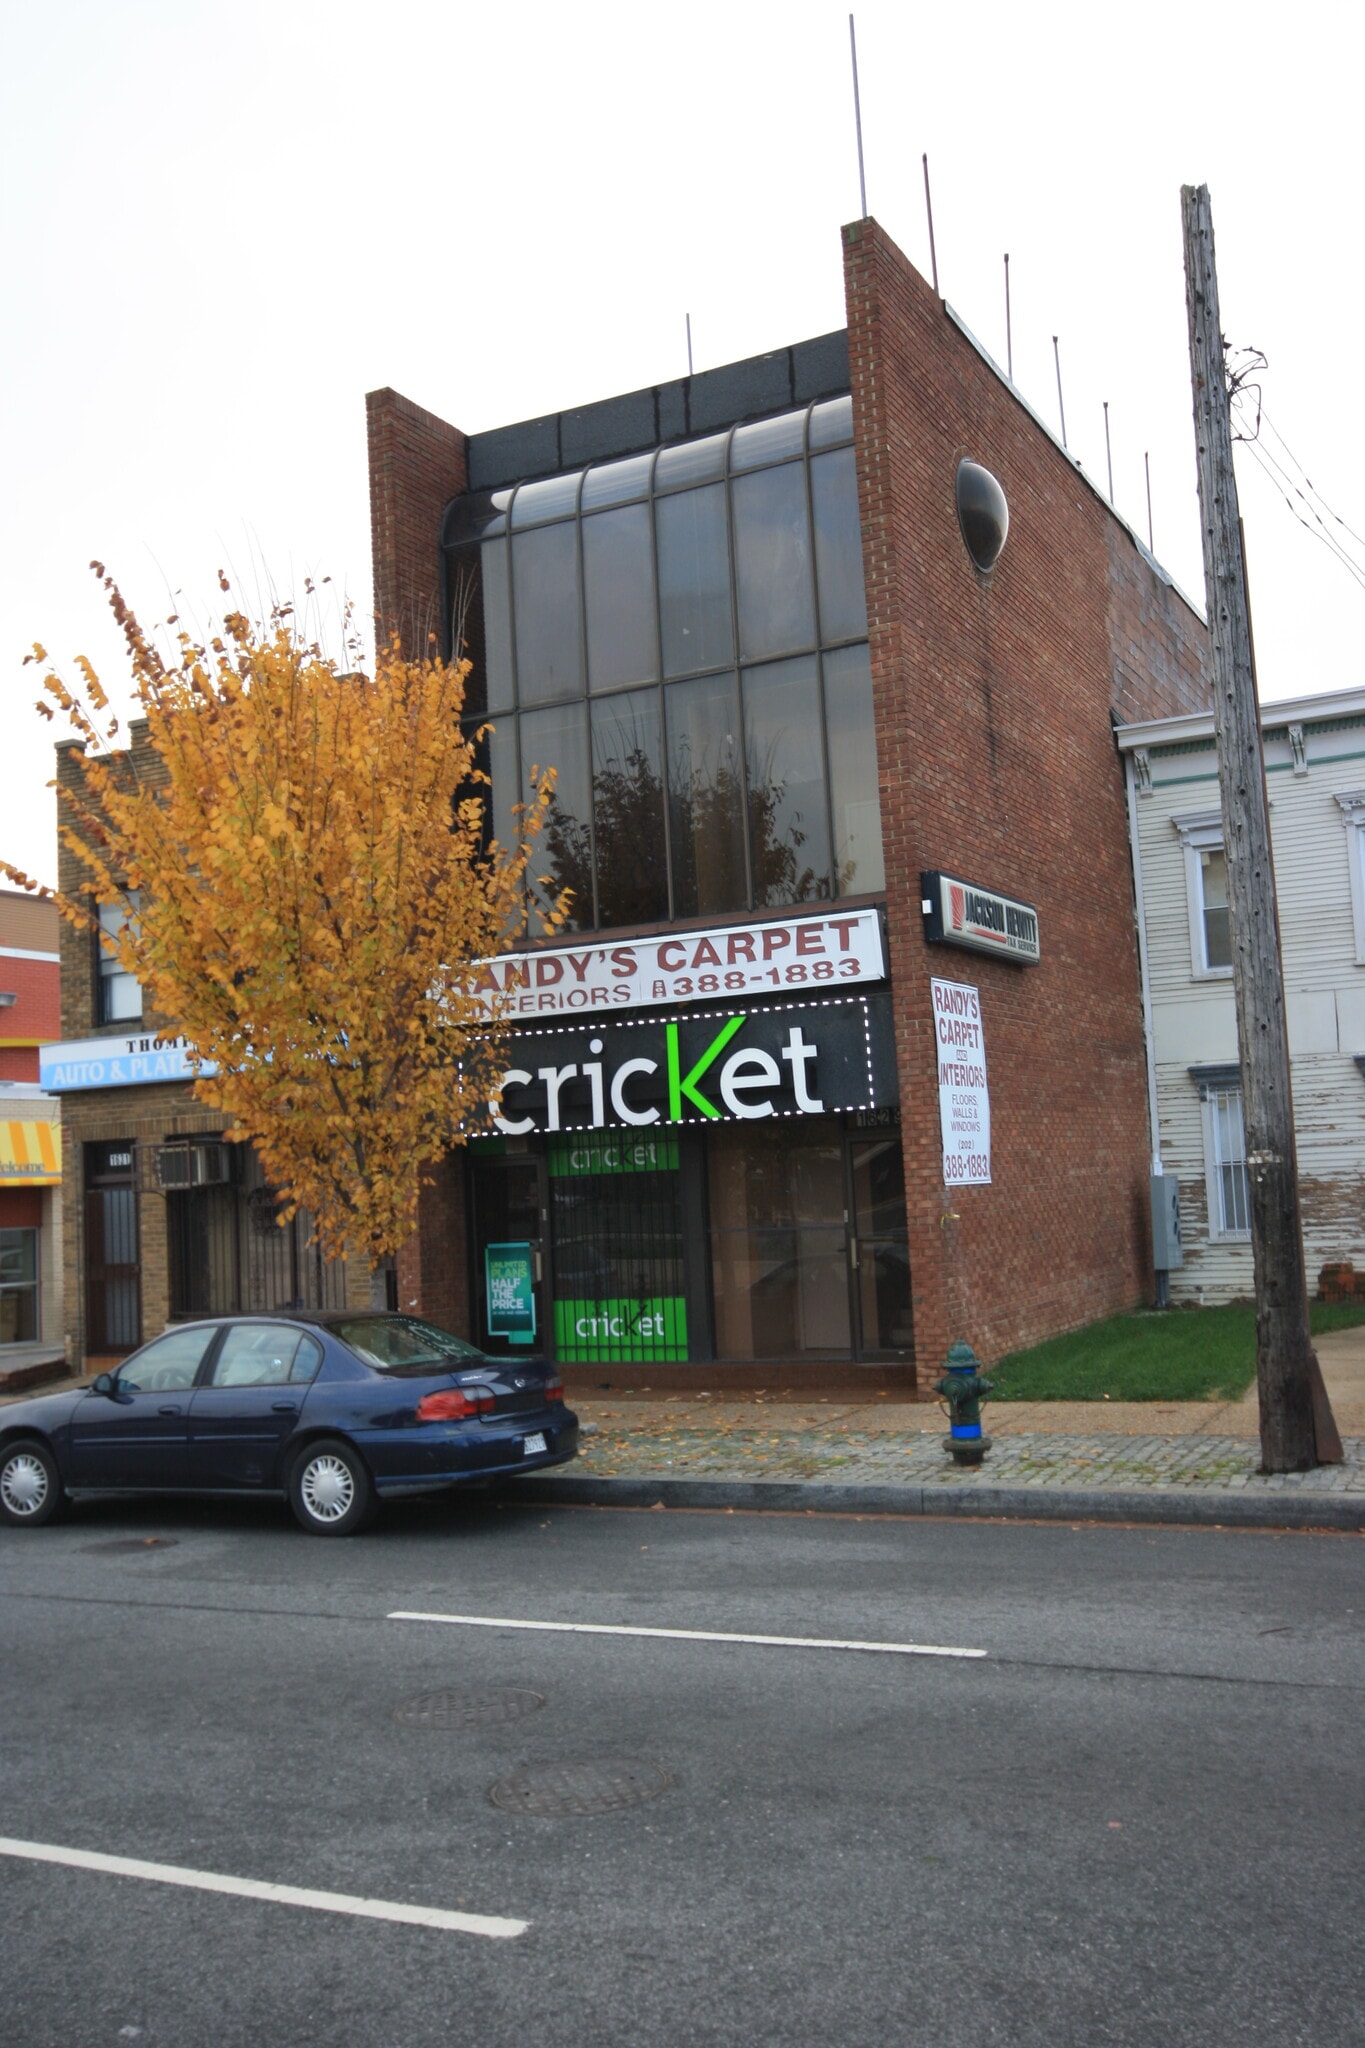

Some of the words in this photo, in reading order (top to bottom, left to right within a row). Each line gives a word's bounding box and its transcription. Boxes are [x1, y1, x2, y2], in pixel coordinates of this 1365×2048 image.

[964, 890, 1005, 933] JACKSON
[1005, 904, 1037, 943] HEWITT
[656, 917, 860, 972] CARPET
[1017, 938, 1037, 954] SERVICE
[673, 958, 861, 996] 388-1883
[934, 985, 978, 1019] RANDY'S
[938, 1017, 979, 1049] CARPET
[53, 1062, 104, 1086] AUTO
[110, 1060, 126, 1080] &
[939, 1062, 984, 1088] INTERIORS
[951, 1108, 973, 1119] WALLS
[951, 1121, 980, 1132] WINDOWS
[958, 1139, 975, 1150] (202)
[945, 1154, 988, 1178] 388-1883
[490, 1268, 528, 1279] PLANS
[491, 1278, 521, 1289] HALF
[492, 1288, 514, 1299] THE
[492, 1298, 524, 1310] PRICE
